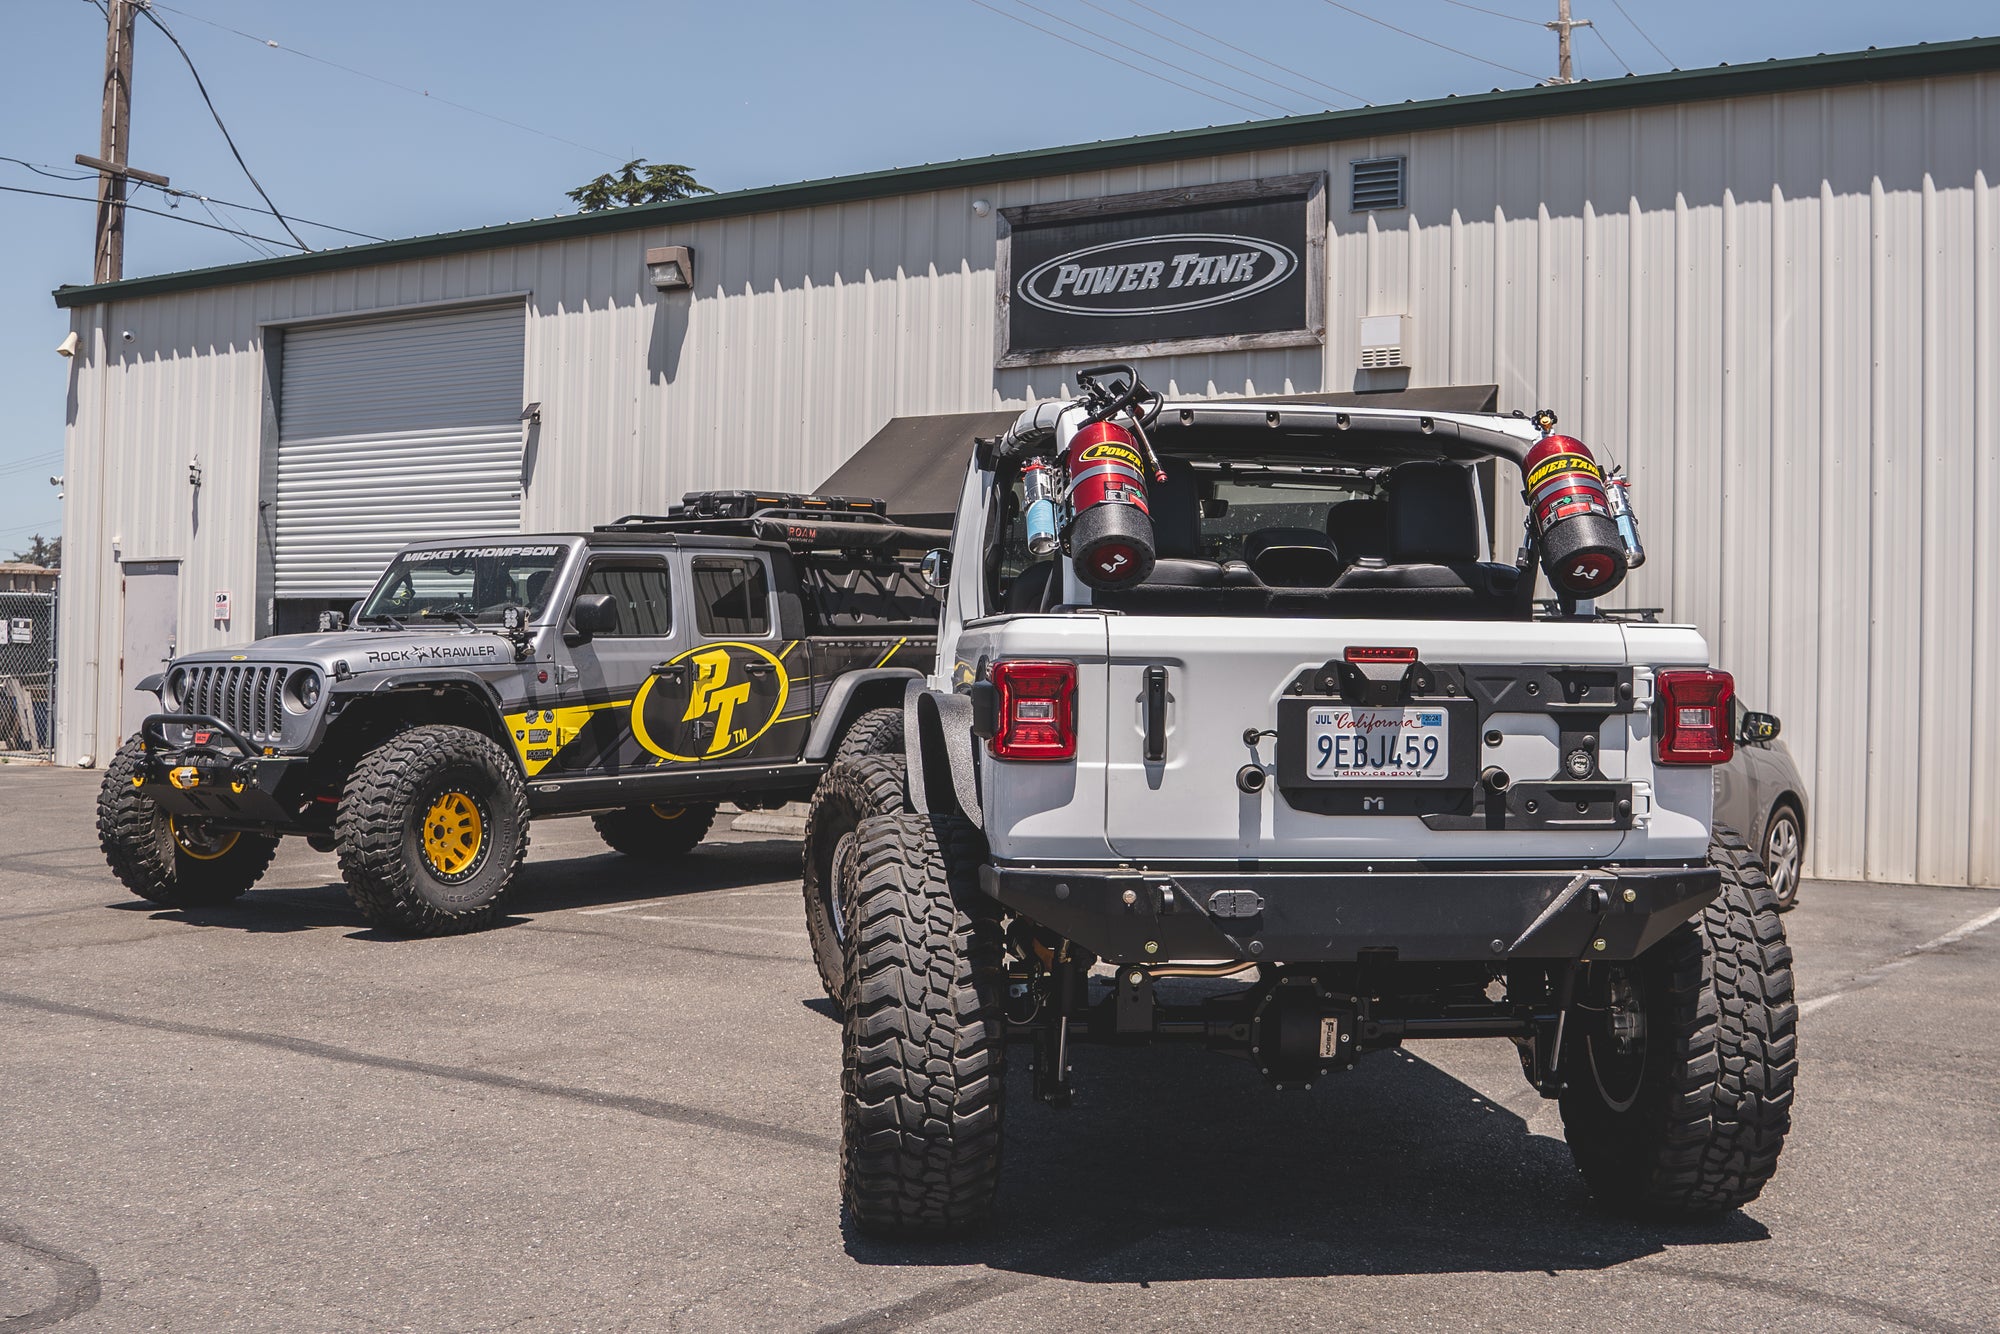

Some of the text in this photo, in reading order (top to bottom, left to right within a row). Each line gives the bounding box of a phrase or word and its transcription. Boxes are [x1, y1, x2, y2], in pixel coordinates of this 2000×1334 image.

[1048, 252, 1261, 298] POWER TANK
[1094, 445, 1141, 467] POWER
[1528, 459, 1568, 491] POWER
[789, 526, 817, 539] ROAM
[402, 546, 559, 563] MICKEY THOMPSON
[365, 645, 496, 663] ROCK KRAWLER
[682, 649, 751, 754] PT
[1315, 714, 1332, 725] JUL
[1337, 712, 1423, 734] California
[733, 728, 748, 744] TM
[1316, 735, 1439, 769] 9EBJ459
